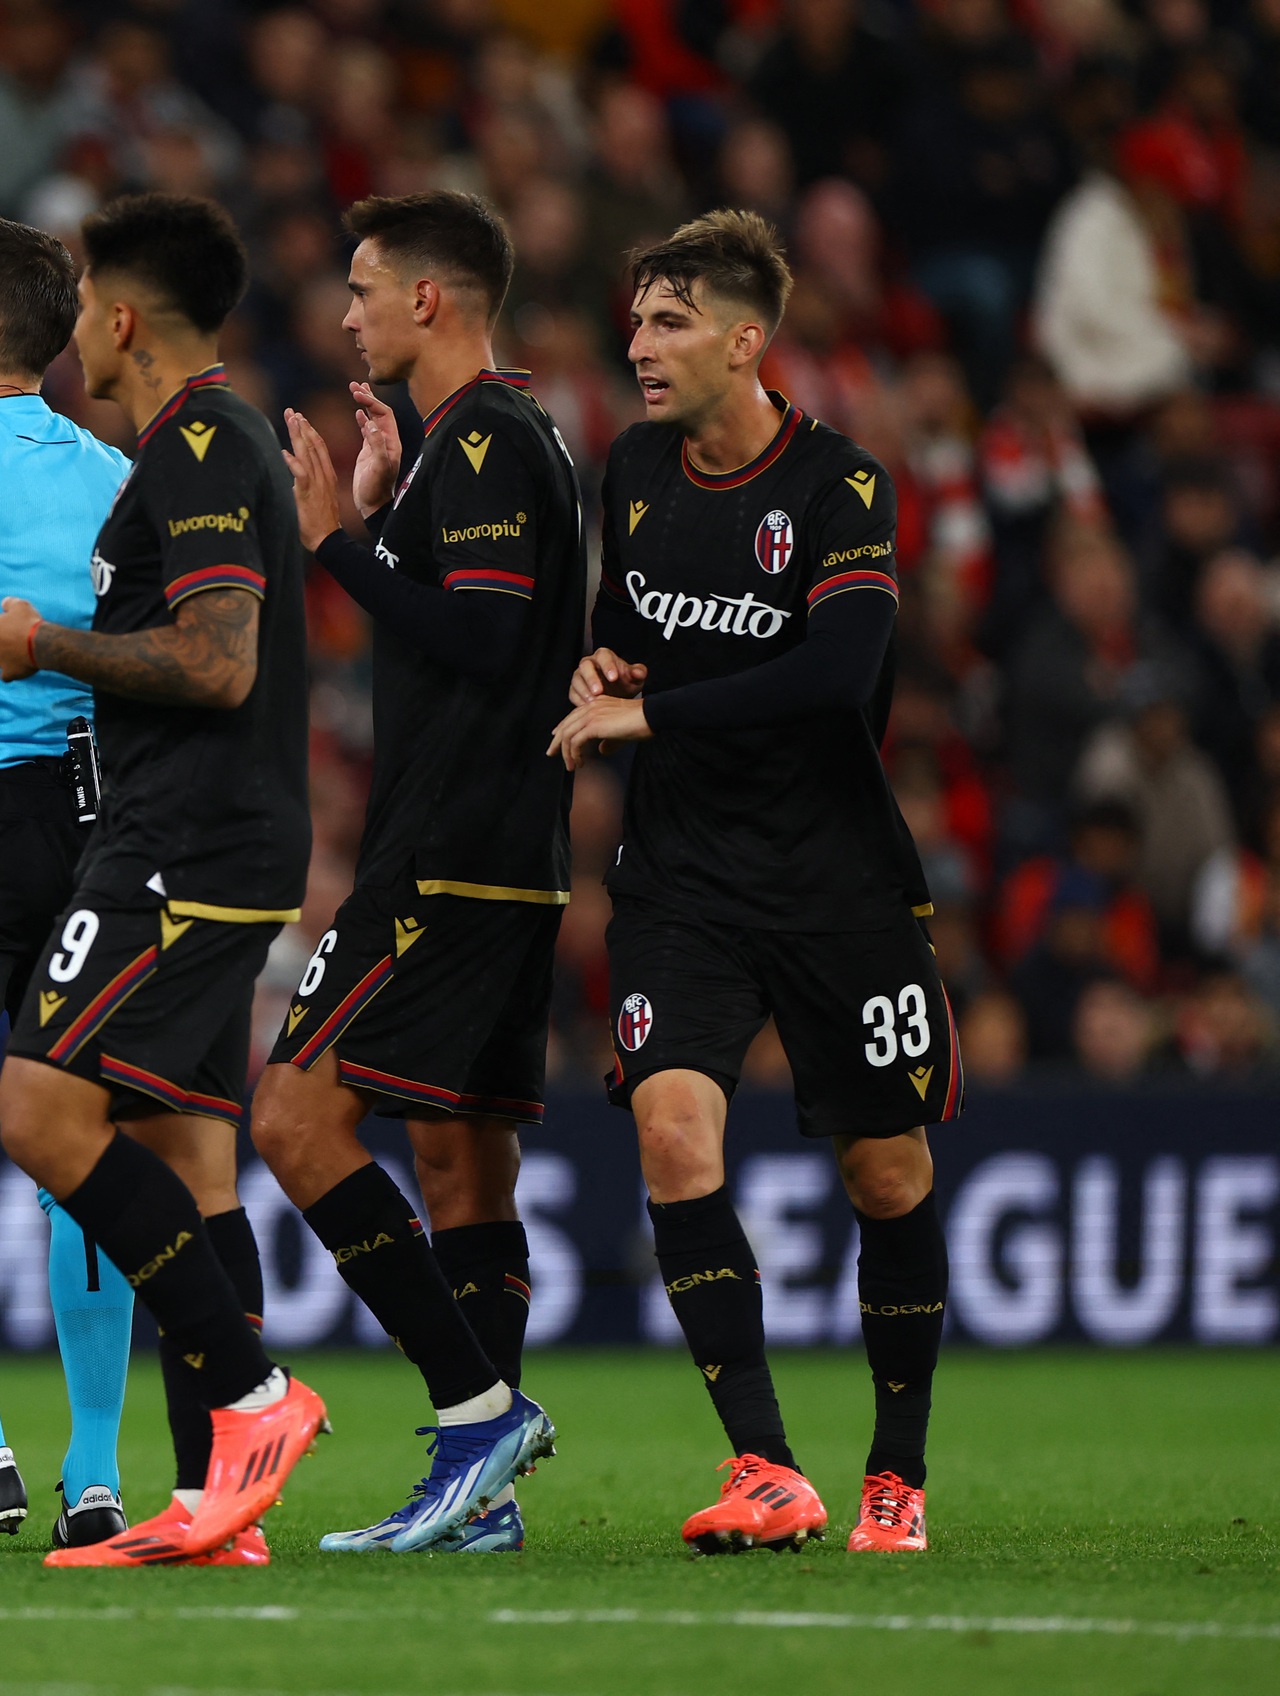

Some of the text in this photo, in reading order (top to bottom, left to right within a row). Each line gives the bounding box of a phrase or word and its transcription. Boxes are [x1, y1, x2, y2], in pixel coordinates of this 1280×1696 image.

[767, 512, 786, 526] BFC
[625, 570, 792, 641] Saputo
[48, 909, 100, 983] 9
[297, 929, 338, 997] 6
[862, 983, 931, 1067] 33
